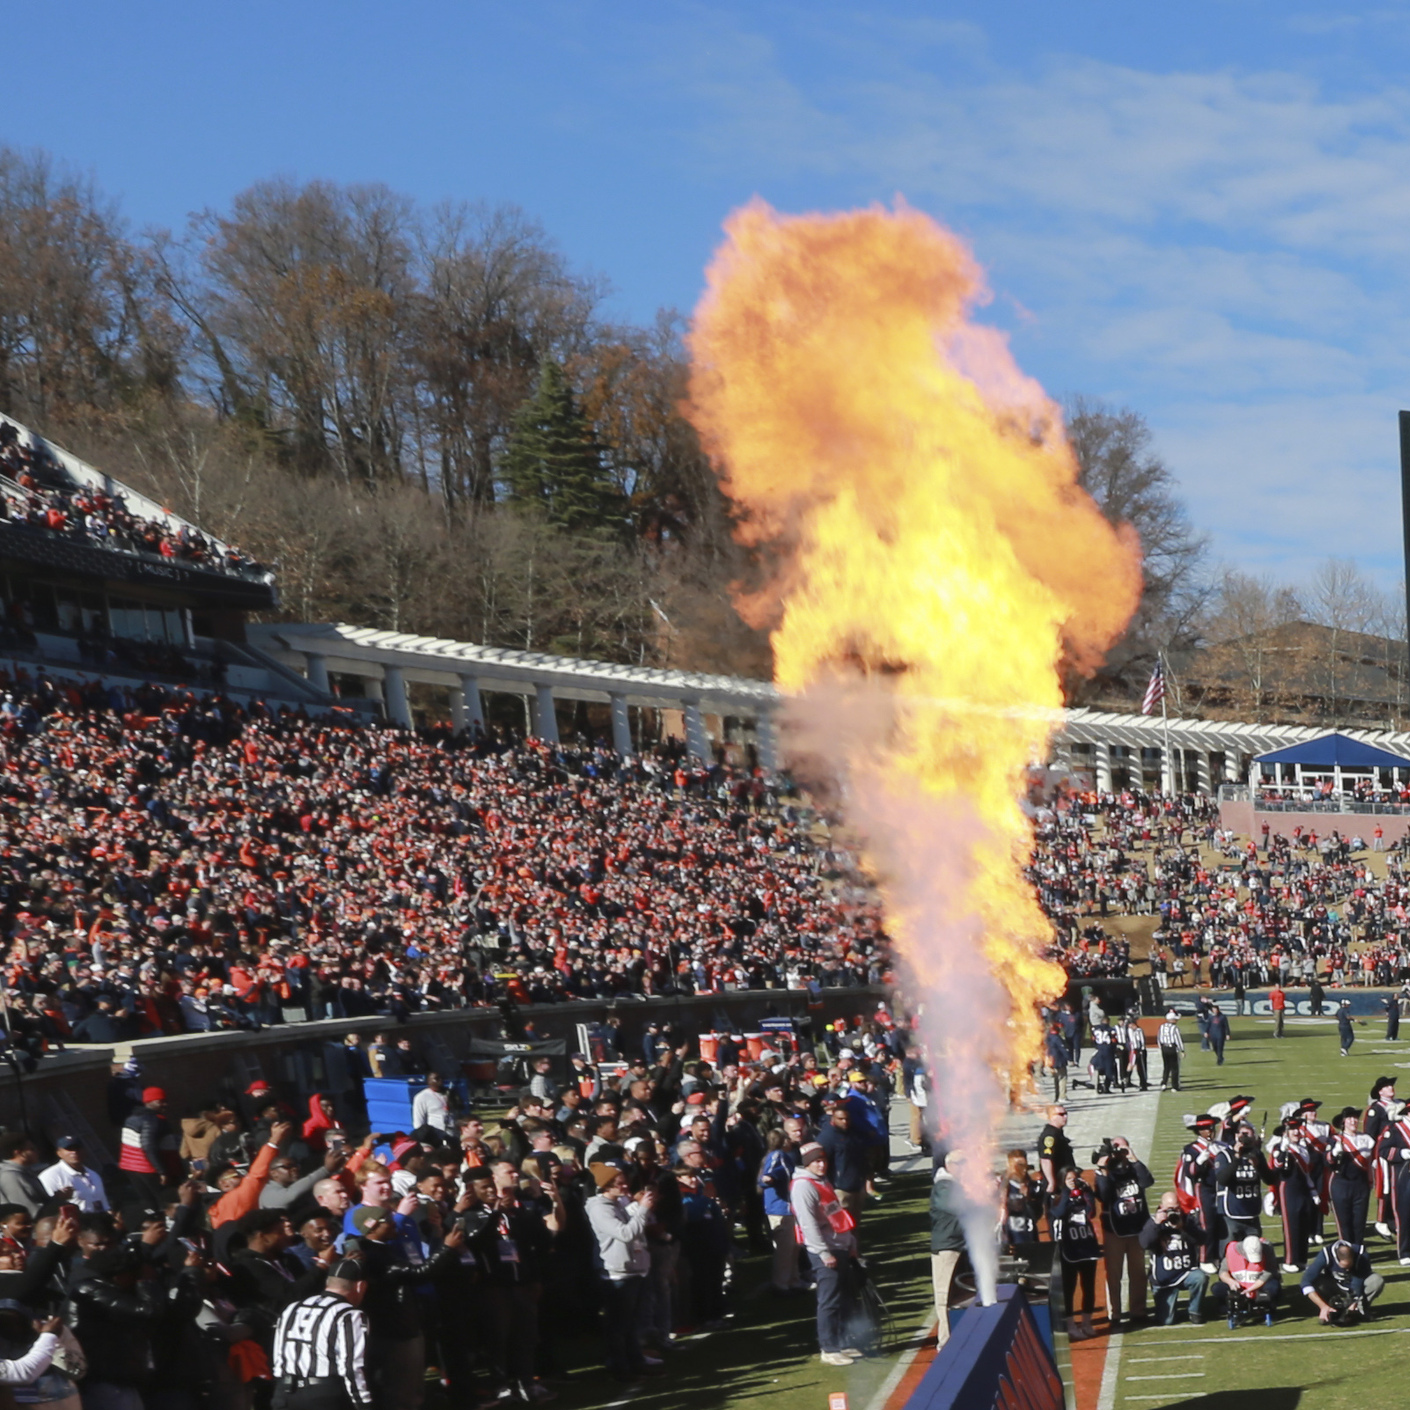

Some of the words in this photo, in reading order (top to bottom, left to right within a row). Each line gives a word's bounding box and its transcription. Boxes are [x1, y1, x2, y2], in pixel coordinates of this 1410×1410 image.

[1094, 1030, 1110, 1044] 34
[1163, 1257, 1191, 1271] 085
[287, 1306, 323, 1341] H
